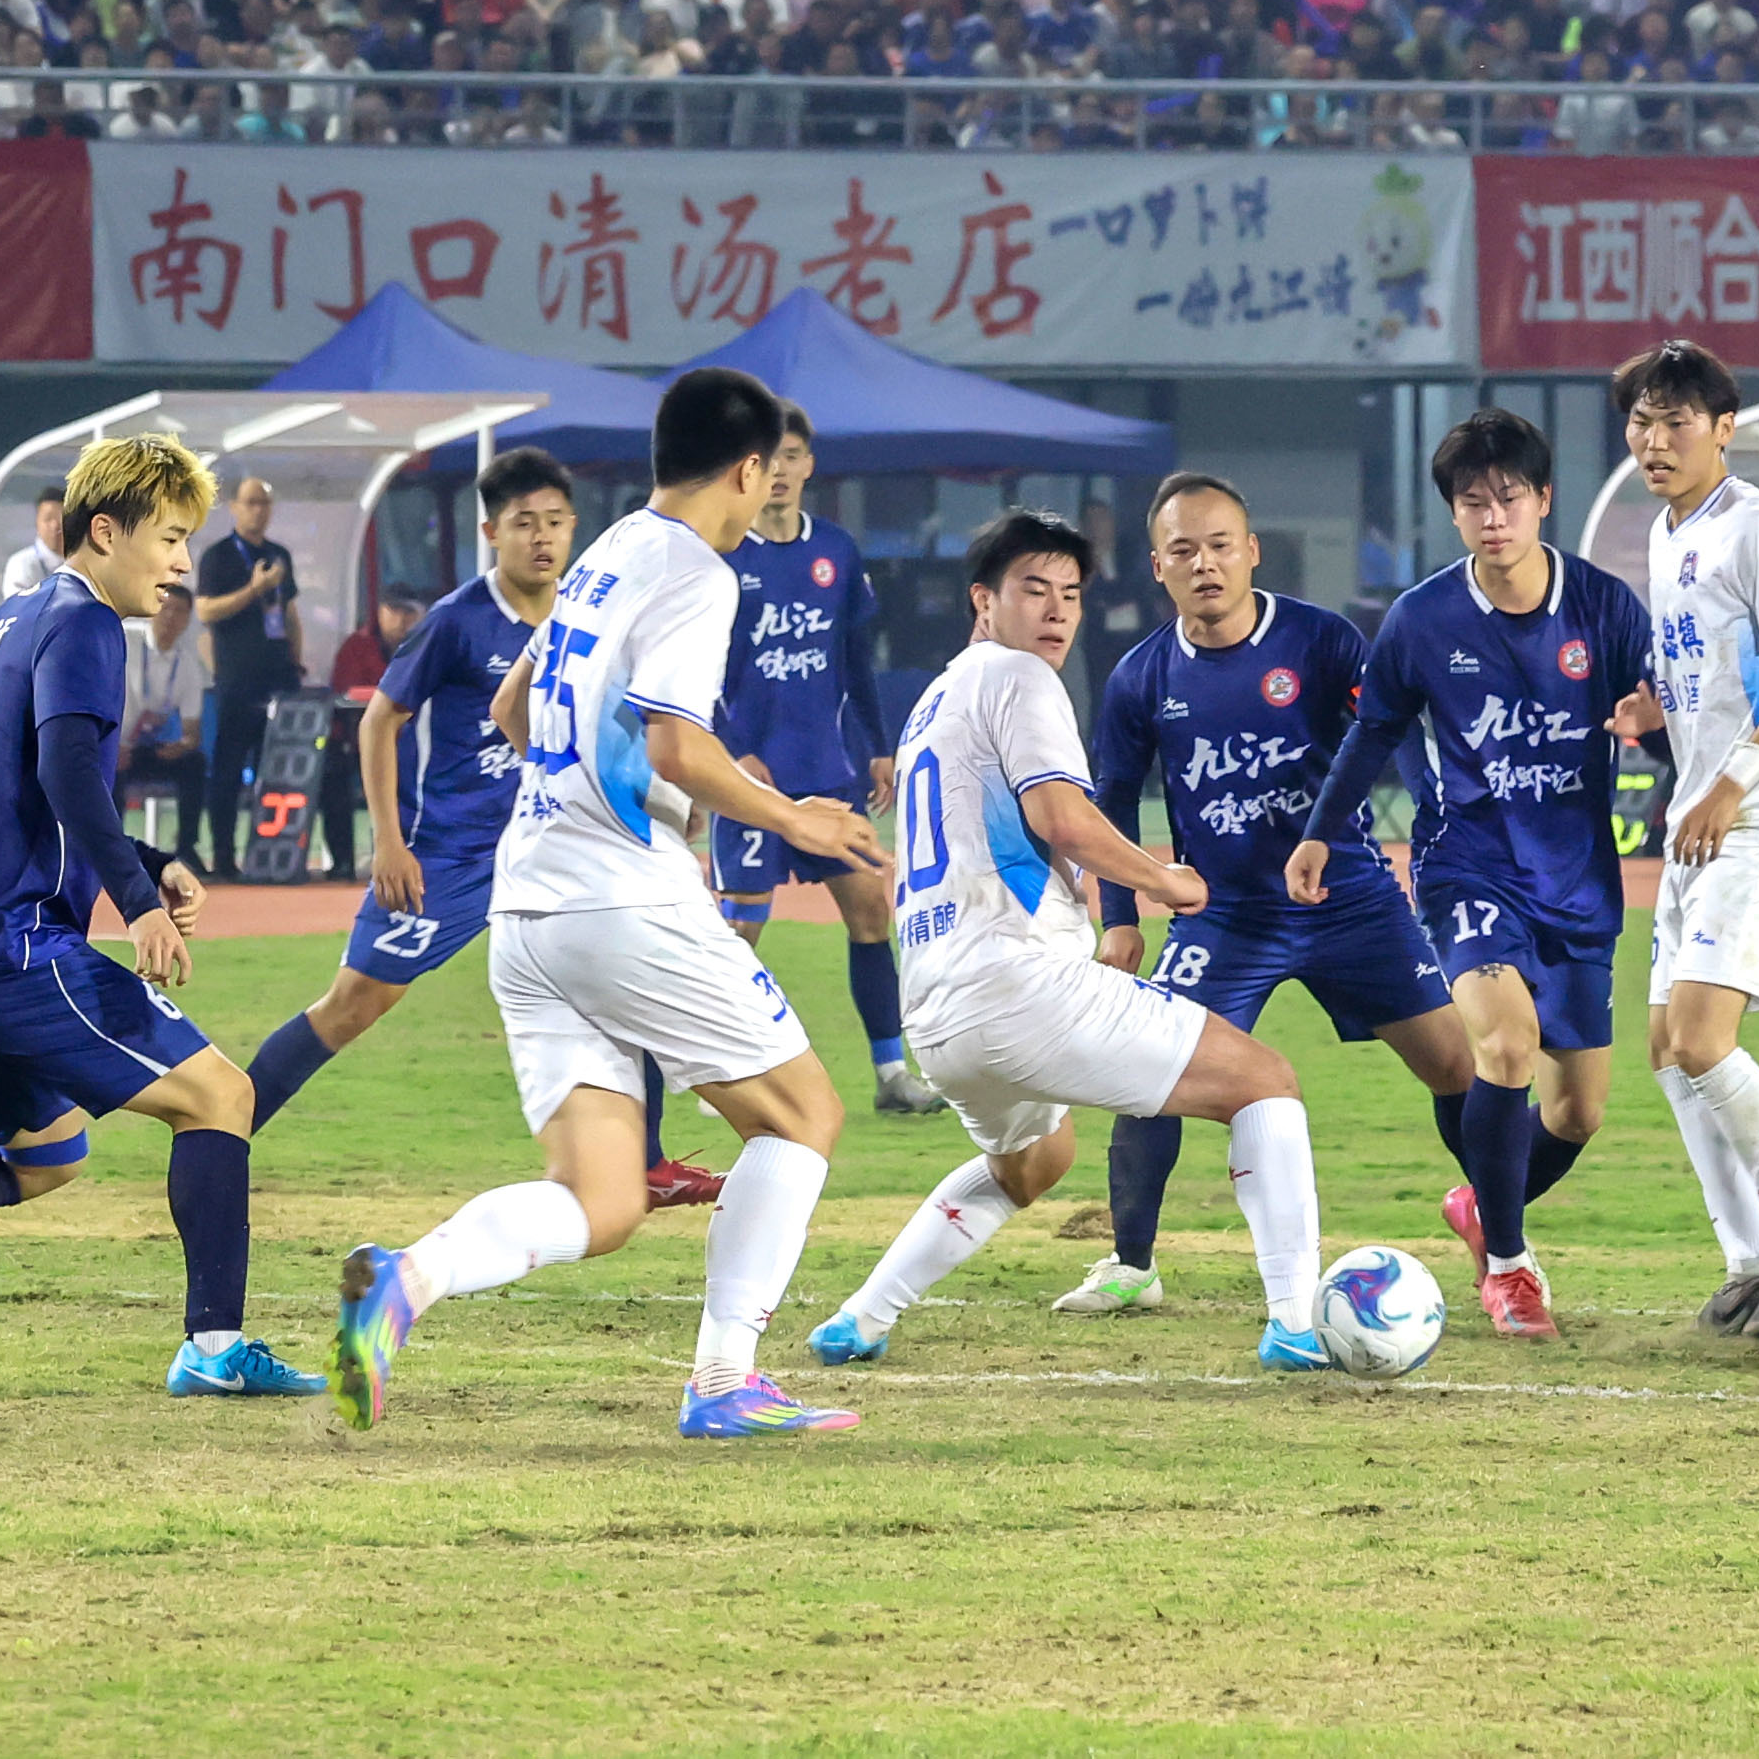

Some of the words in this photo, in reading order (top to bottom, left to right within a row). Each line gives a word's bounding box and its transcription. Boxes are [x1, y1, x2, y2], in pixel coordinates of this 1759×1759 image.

[129, 168, 1044, 341] 南门口清汤老店
[750, 602, 834, 646] 九江
[1460, 693, 1593, 751] 九江
[1180, 731, 1312, 793] 九江
[741, 829, 764, 868] 2
[372, 909, 440, 958] 23
[1451, 899, 1500, 944] 17
[1151, 942, 1211, 987] 18
